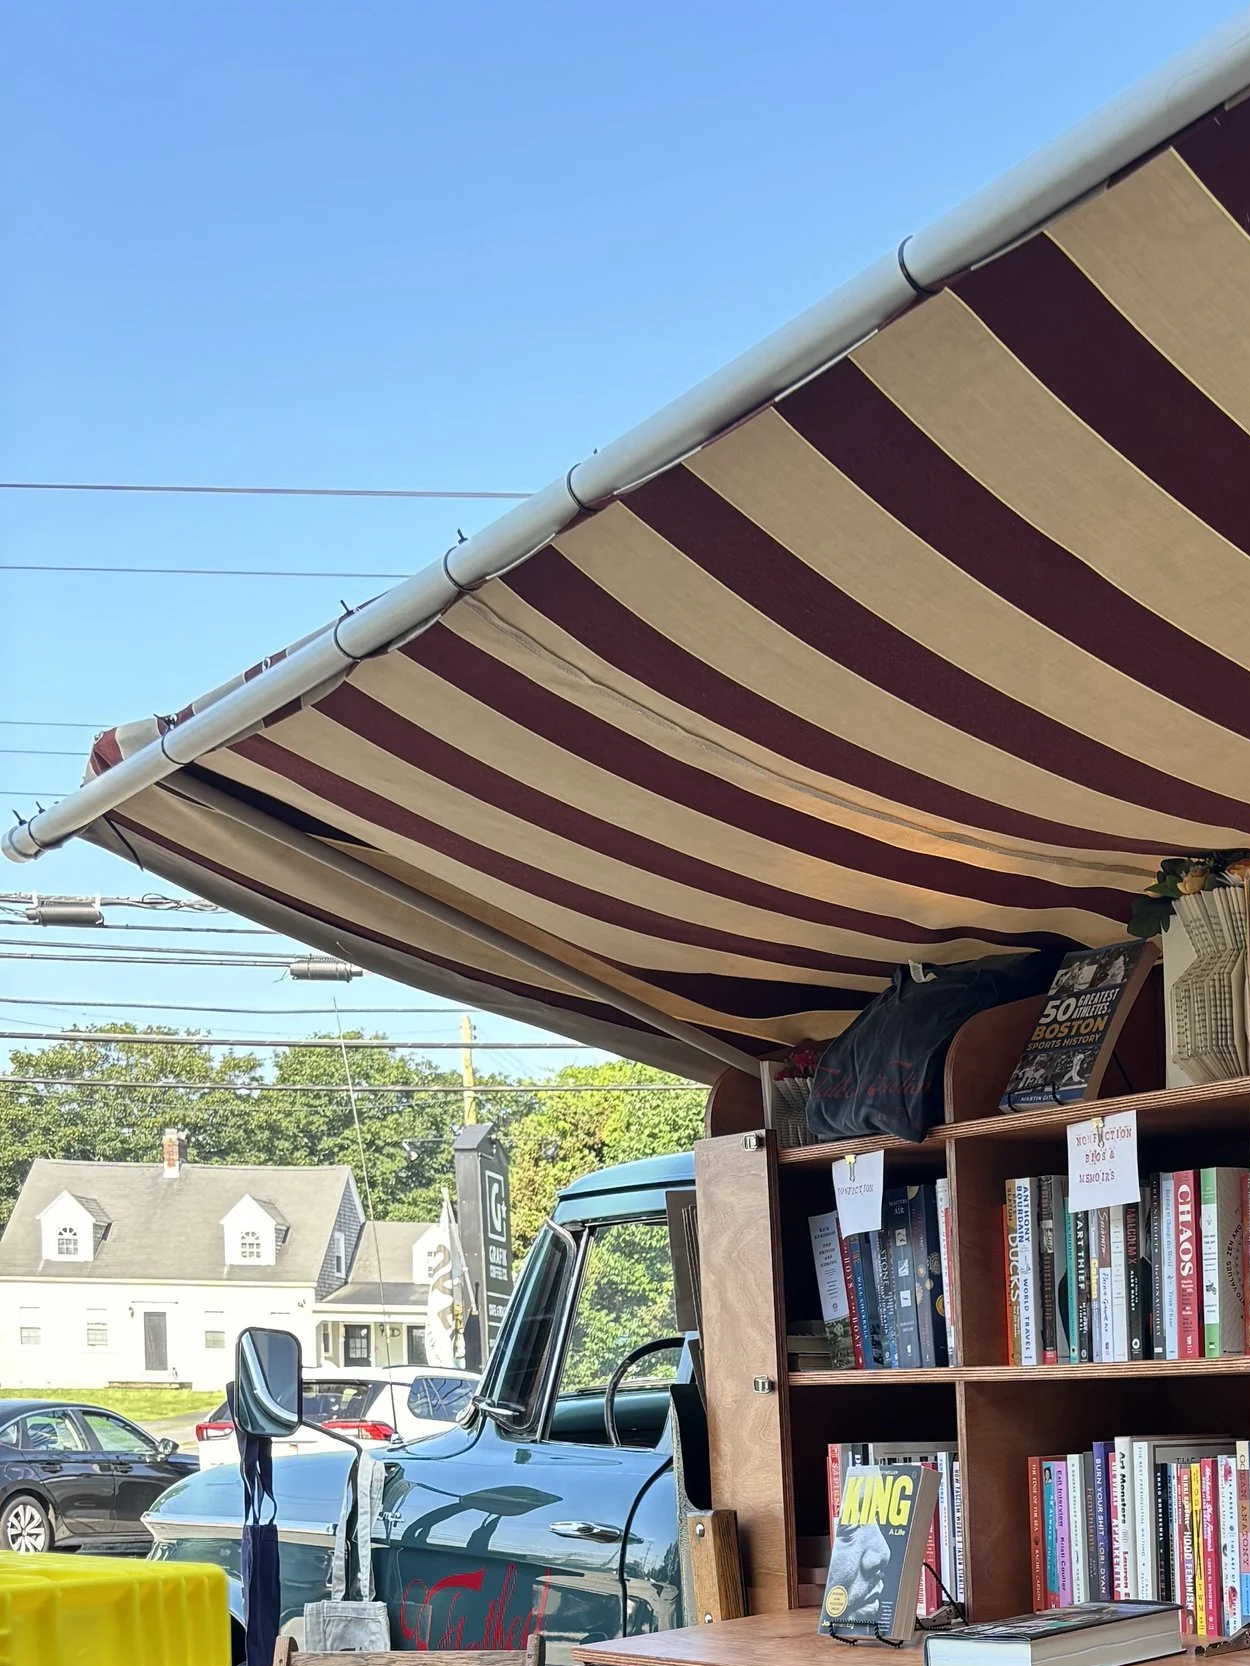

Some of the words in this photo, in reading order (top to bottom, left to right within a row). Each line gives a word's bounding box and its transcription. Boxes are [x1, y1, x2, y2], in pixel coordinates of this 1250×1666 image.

[1039, 998, 1076, 1024] 50
[1072, 1002, 1109, 1019] ATHLETES
[1078, 988, 1120, 1006] GREATEST
[1027, 1039, 1062, 1051] SPORTS
[1062, 1033, 1101, 1046] HISTORY
[1031, 1016, 1109, 1041] BOSTON
[1085, 1151, 1105, 1163] BIOS
[1079, 1171, 1115, 1183] MEMOIRS
[1022, 1186, 1030, 1243] ANTHONY
[1077, 1221, 1085, 1245] ART
[1126, 1209, 1137, 1256] MALCOLM
[1178, 1184, 1193, 1276] CHAOS
[1008, 1233, 1020, 1302] DUCKS
[1078, 1252, 1086, 1291] THIEF
[1128, 1257, 1137, 1265] X
[852, 1317, 862, 1348] BOAT
[1239, 1454, 1247, 1499] OCEAN
[840, 1475, 914, 1527] KING
[1183, 1532, 1192, 1560] HOOD
[1241, 1505, 1249, 1567] ANATOMY
[1185, 1564, 1194, 1610] FEMINISM
